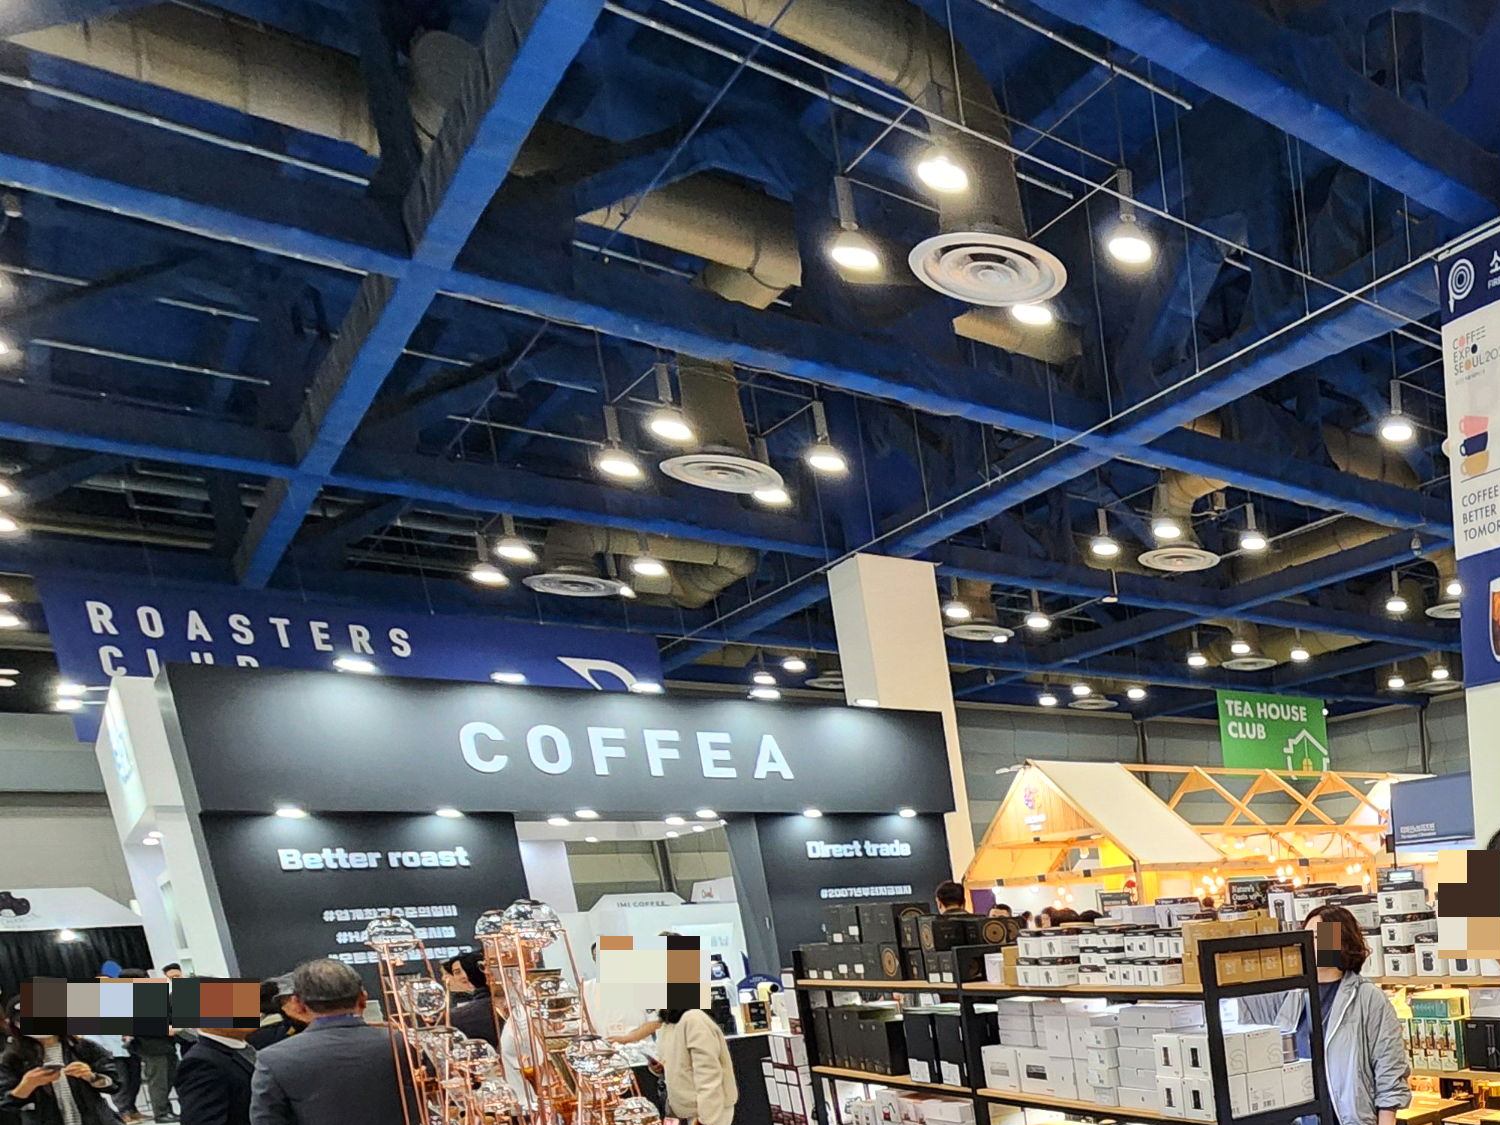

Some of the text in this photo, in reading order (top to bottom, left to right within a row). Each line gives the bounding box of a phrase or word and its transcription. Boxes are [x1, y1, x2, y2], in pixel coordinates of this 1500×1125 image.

[1462, 485, 1499, 507] COFFEE
[1463, 503, 1497, 525] BETTER
[85, 600, 412, 658] ROASTERS
[98, 645, 260, 677] CL
[1225, 699, 1307, 722] TEA HOUSE
[1227, 722, 1266, 740] CLUB
[459, 721, 795, 780] COFFEA
[277, 846, 471, 871] Better roast
[805, 839, 911, 858] Direct trade
